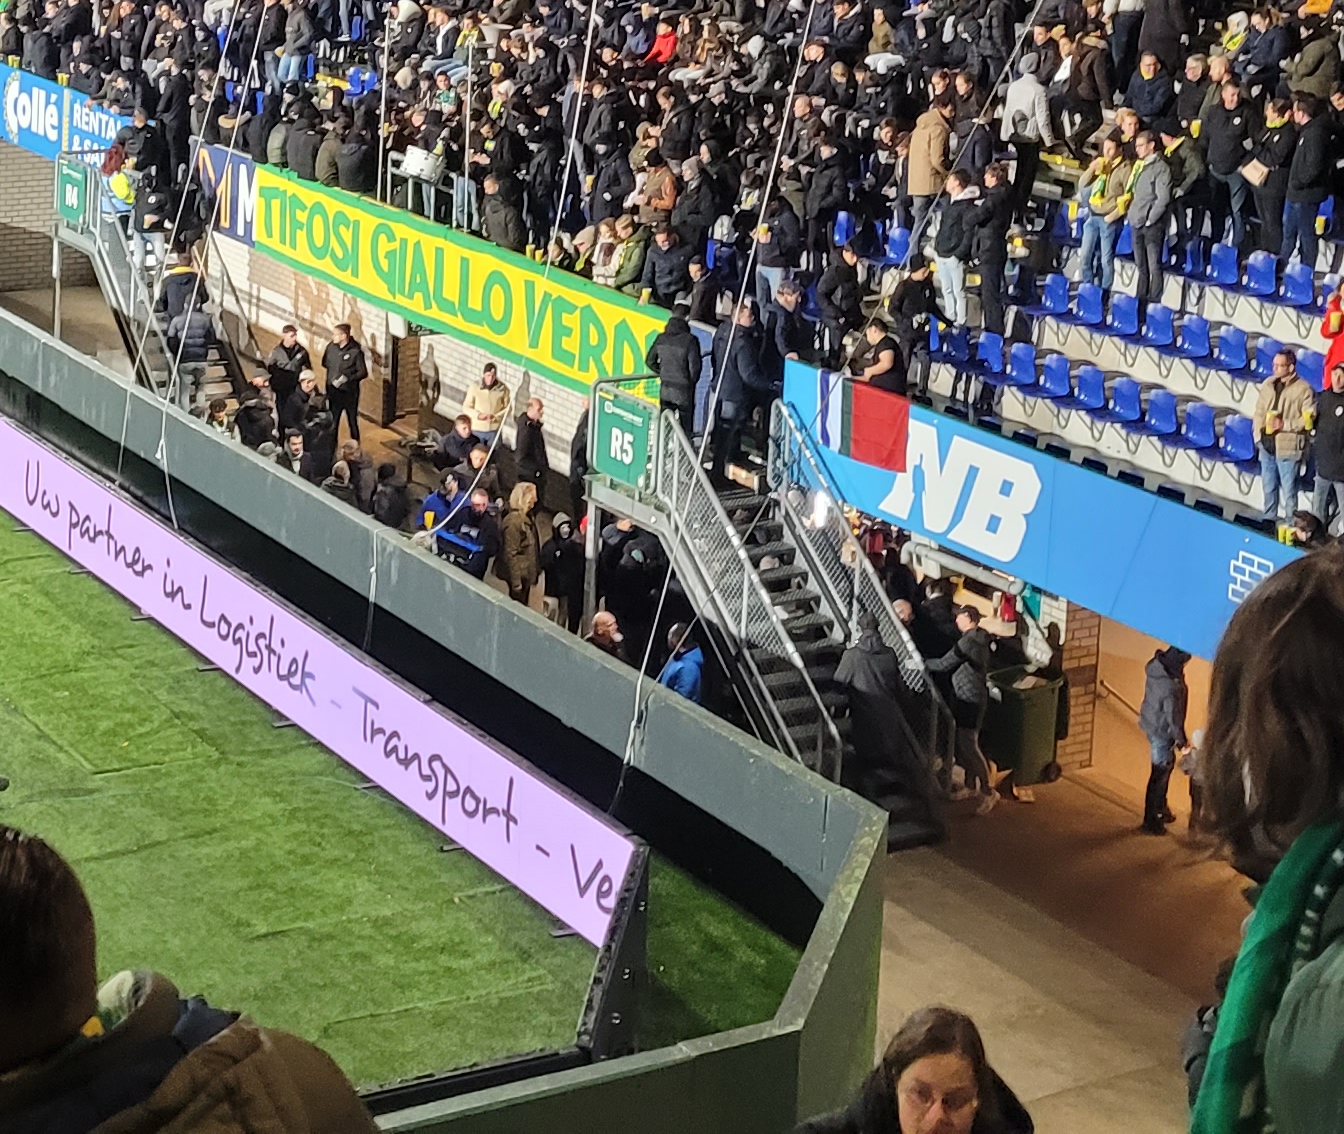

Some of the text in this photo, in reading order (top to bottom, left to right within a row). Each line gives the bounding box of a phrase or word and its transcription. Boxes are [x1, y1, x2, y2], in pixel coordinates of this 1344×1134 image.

[6, 78, 59, 142] Collé
[65, 183, 79, 210] R4
[258, 185, 361, 280] TIFOSI
[370, 222, 514, 336] GIALLO
[610, 426, 634, 465] R5
[25, 460, 60, 518] Uw
[68, 501, 154, 577] partner
[163, 558, 192, 611] in
[200, 574, 316, 707] Logistiek
[351, 685, 519, 844] Transport
[570, 843, 618, 915] Ve
